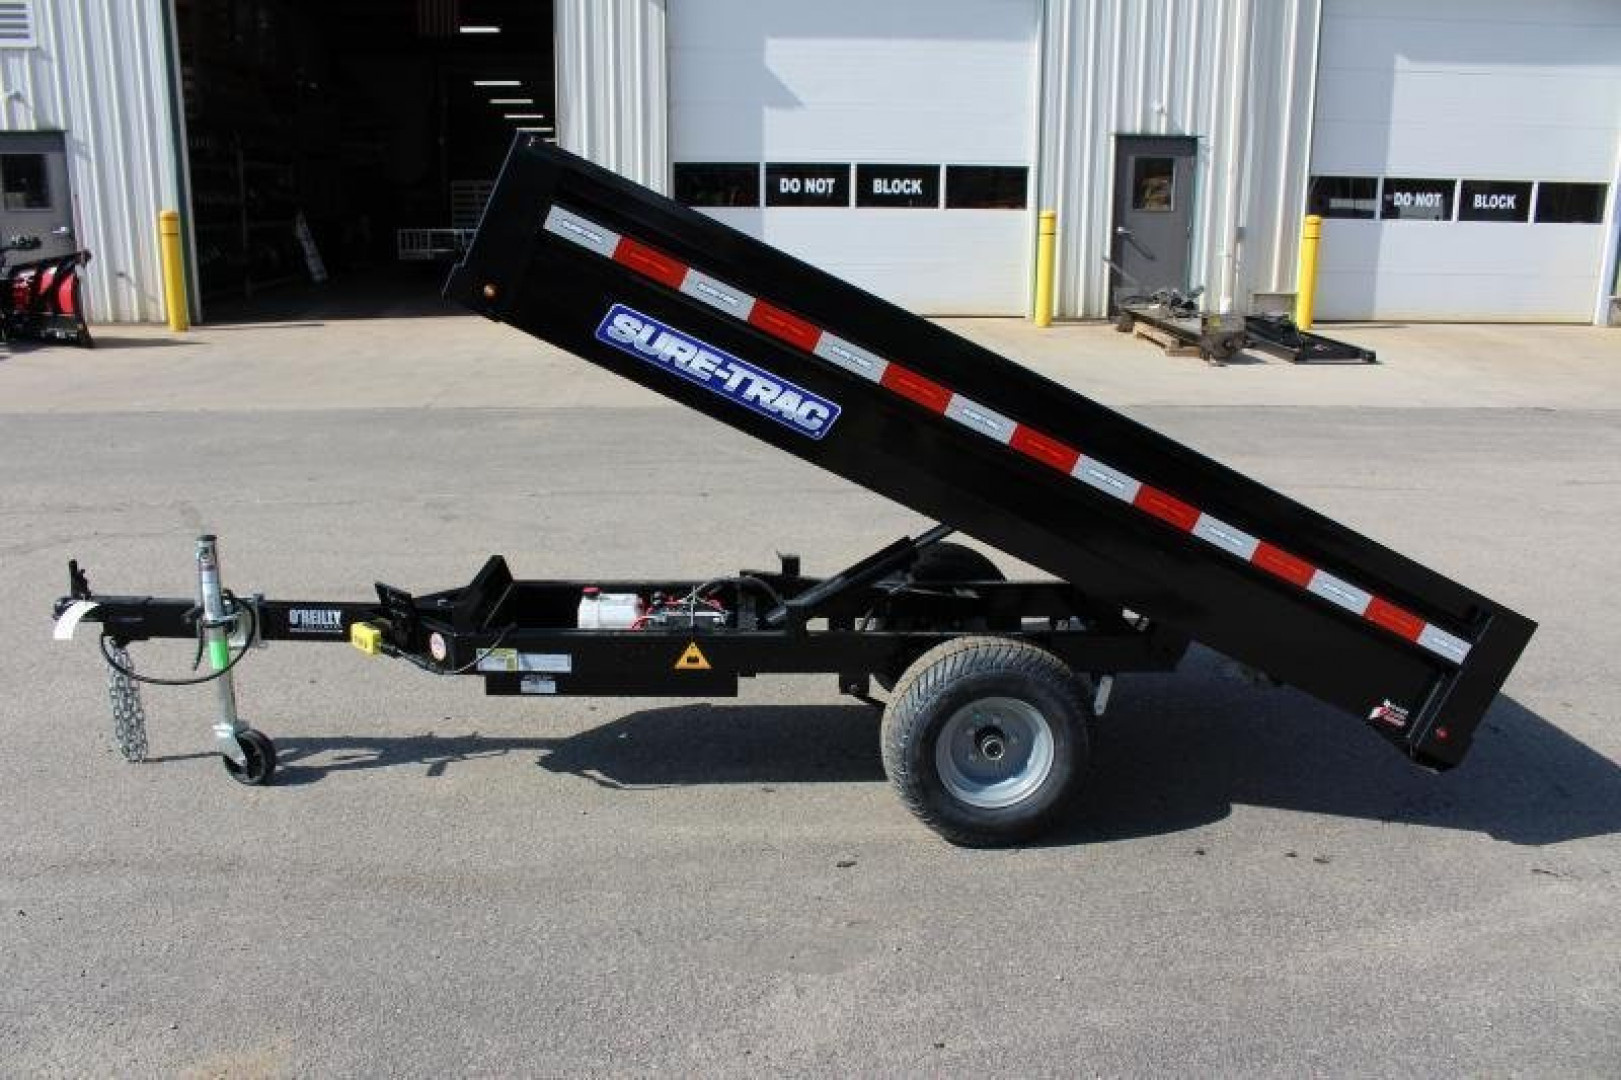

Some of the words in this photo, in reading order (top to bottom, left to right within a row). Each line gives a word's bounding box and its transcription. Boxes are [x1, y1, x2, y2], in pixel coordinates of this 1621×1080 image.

[779, 177, 801, 193] DO
[804, 177, 836, 194] NOT
[872, 177, 923, 194] BLOCK
[1394, 192, 1411, 206] DO
[1414, 192, 1442, 207] NOT
[1473, 193, 1516, 209] BLOCK
[606, 313, 830, 431] SURE-TRAC
[289, 609, 342, 625] O'REILLY
